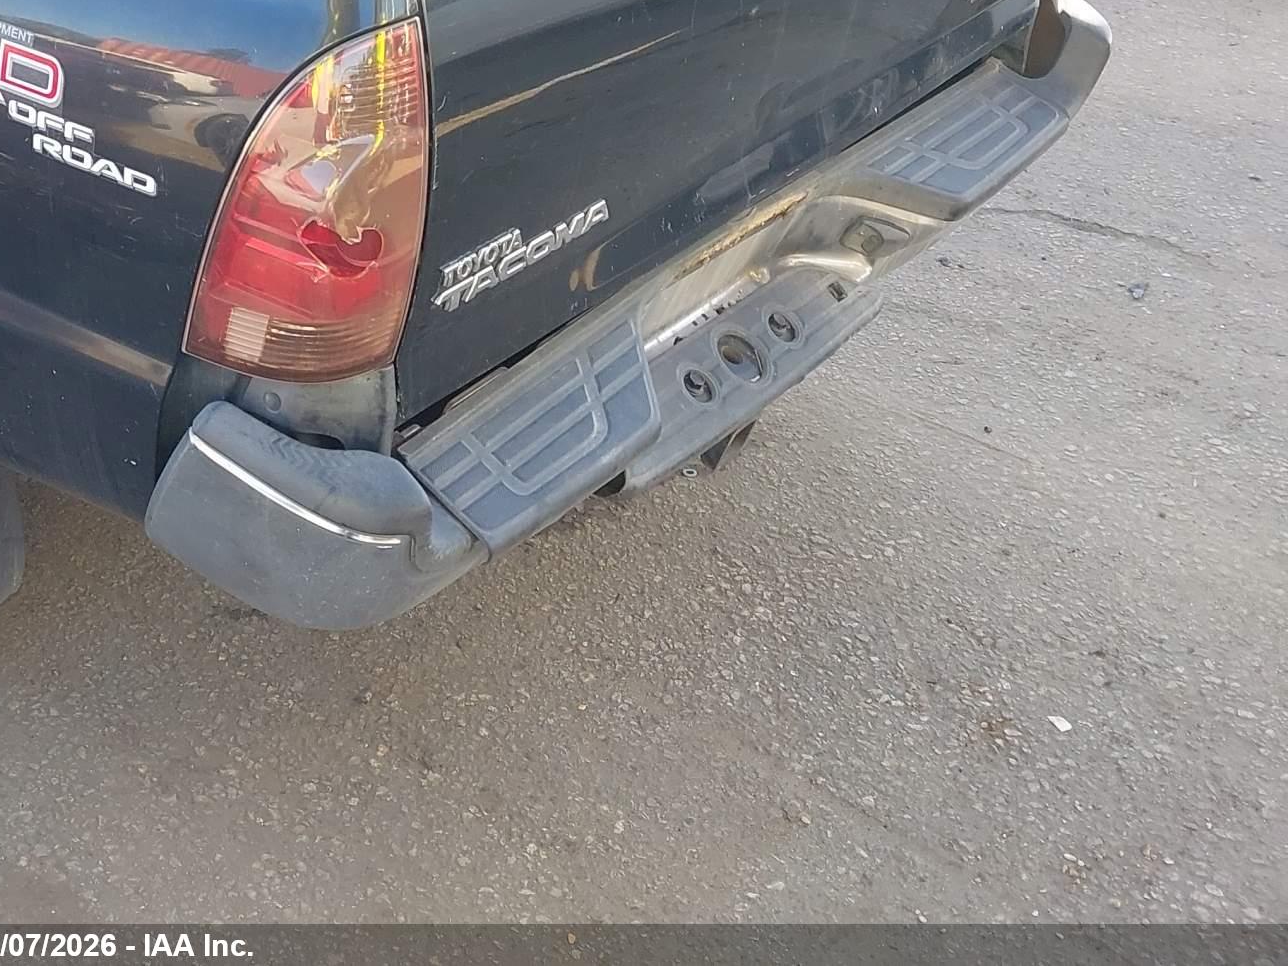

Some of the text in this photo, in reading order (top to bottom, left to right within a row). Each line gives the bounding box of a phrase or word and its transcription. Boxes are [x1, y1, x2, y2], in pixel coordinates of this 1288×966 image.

[7, 99, 95, 143] OFF
[31, 133, 159, 197] ROAD
[431, 198, 610, 312] TACOMA
[440, 228, 523, 288] TOYOTA
